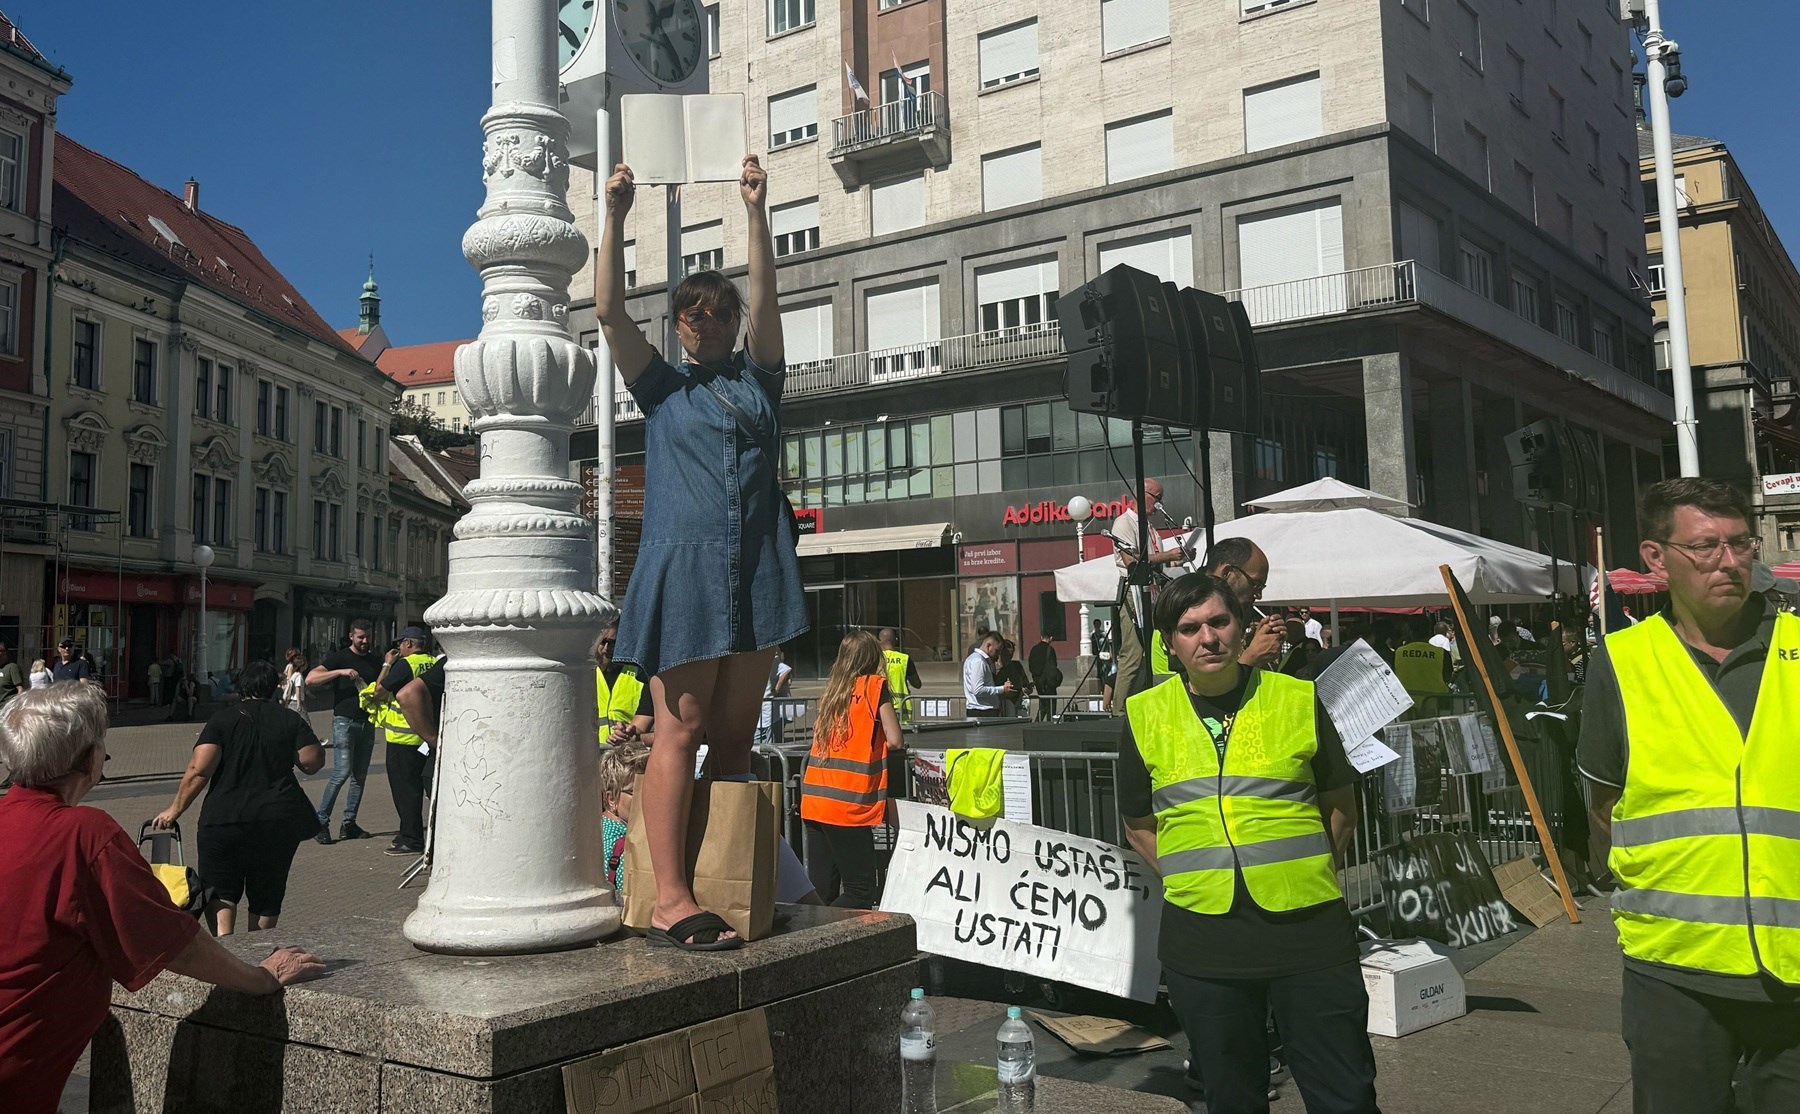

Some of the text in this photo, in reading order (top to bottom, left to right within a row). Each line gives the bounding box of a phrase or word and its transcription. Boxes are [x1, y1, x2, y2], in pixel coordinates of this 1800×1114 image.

[1402, 649, 1436, 660] REDAR
[923, 812, 1150, 901] NISMO USTAŠE,
[923, 866, 1108, 931] ALI ĆEMO
[954, 908, 1062, 962] USTATI
[1420, 984, 1444, 1000] GILDAN
